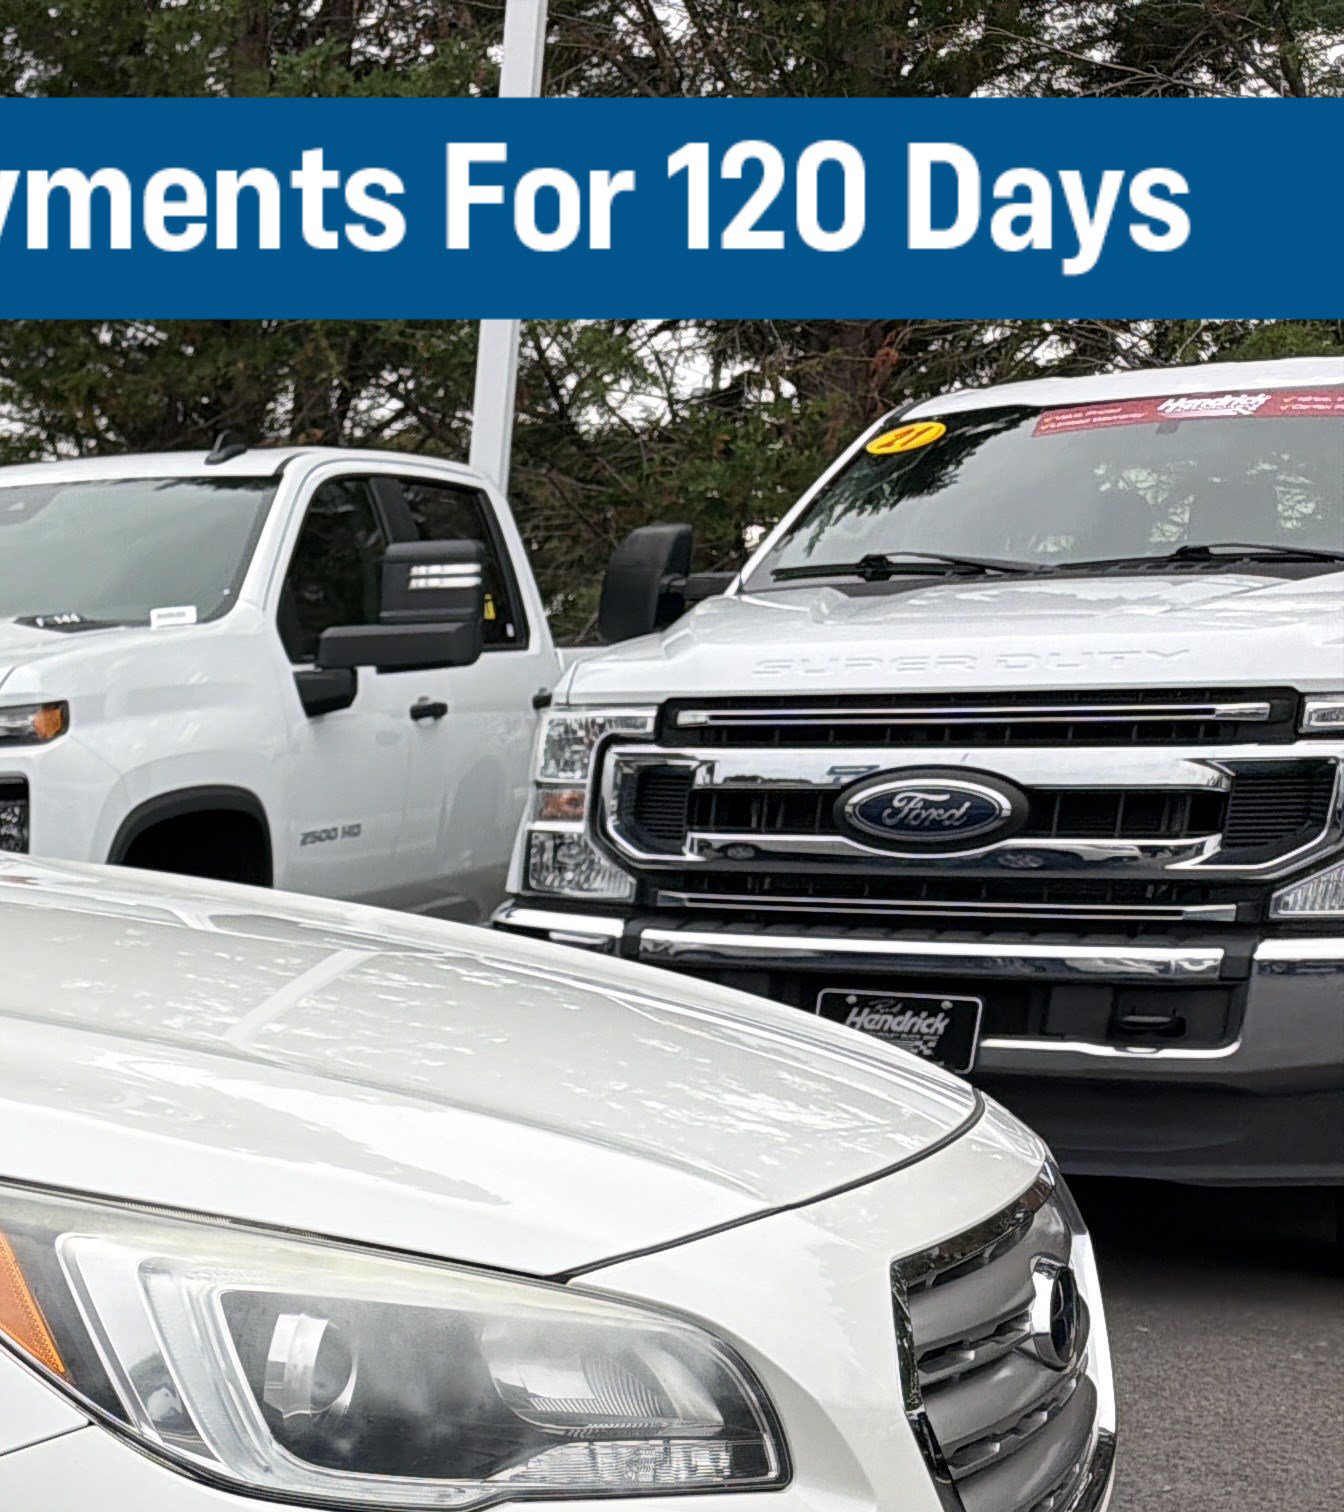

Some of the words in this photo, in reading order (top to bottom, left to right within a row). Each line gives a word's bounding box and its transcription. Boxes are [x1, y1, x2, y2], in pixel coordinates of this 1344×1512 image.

[752, 653, 979, 678] SUPER
[995, 648, 1192, 670] DUTY
[881, 790, 972, 828] Ford
[846, 1007, 951, 1036] Hendrick
